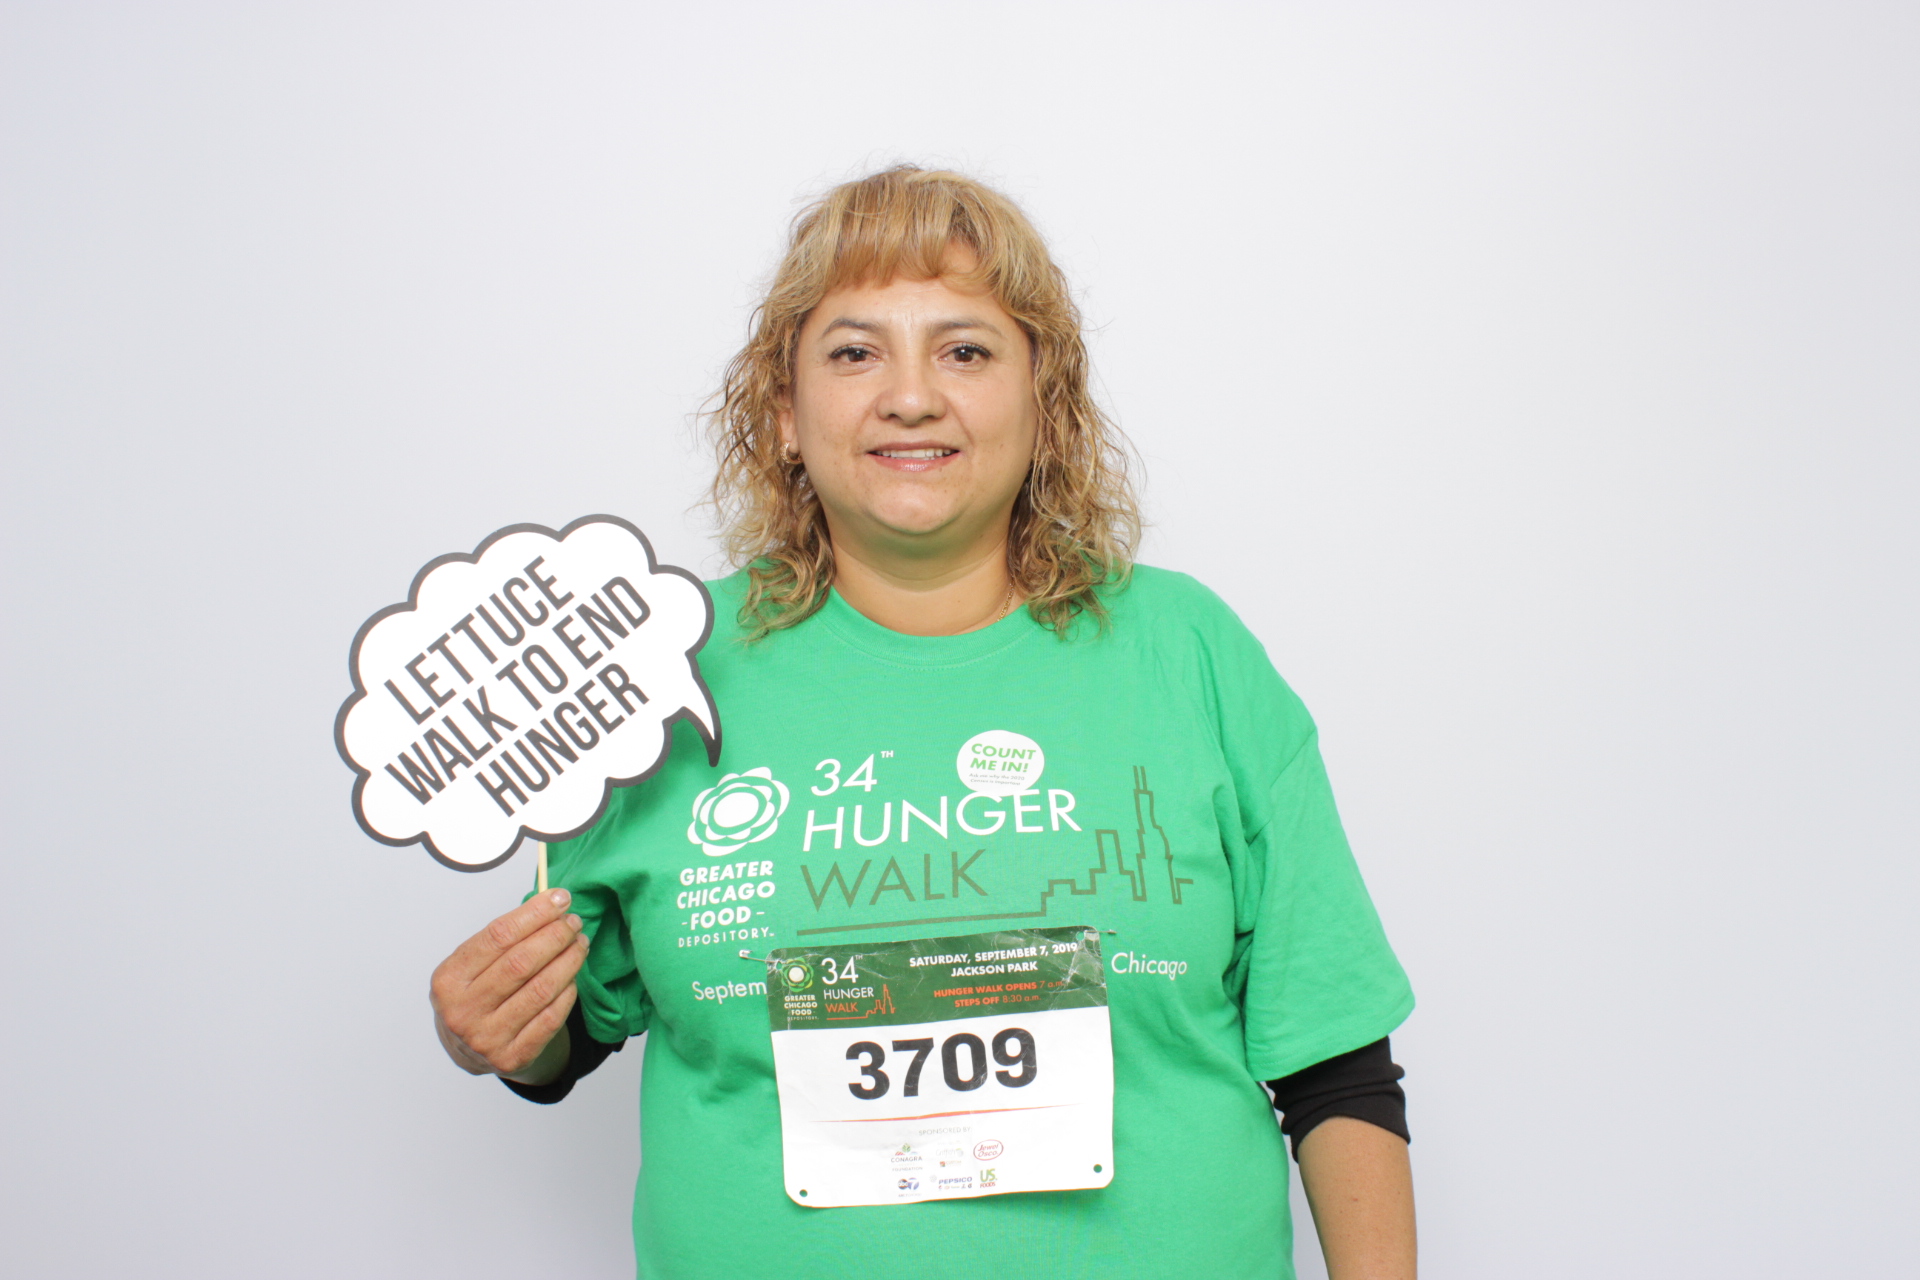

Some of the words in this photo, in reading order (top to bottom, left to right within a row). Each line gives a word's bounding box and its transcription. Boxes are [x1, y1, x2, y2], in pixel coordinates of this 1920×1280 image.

[384, 555, 575, 725] LETTUCE
[384, 685, 518, 805] WALK
[495, 644, 569, 711] TO
[551, 576, 651, 670] END
[474, 663, 650, 817] HUNGER
[971, 743, 1036, 760] COUNT
[970, 757, 997, 771] ME
[1001, 761, 1029, 773] IN!
[803, 788, 1082, 852] HUNGER
[680, 860, 774, 886] GREATER
[800, 848, 988, 912] WALK
[677, 881, 776, 909] CHICAGO
[909, 953, 972, 968] SATURDAY,
[975, 946, 1038, 962] SEPTEMBER
[1039, 945, 1049, 957] 7,
[1052, 942, 1078, 954] 2019
[951, 964, 1005, 977] JACKSON
[1007, 961, 1039, 973] PARK
[1110, 951, 1189, 981] Chicago
[784, 994, 816, 1002] GREATER
[823, 987, 874, 1000] HUNGER
[934, 987, 974, 998] HUNGER
[976, 984, 1003, 994] WALK
[1005, 982, 1037, 992] OPENS
[1039, 980, 1046, 989] 7
[825, 1002, 859, 1013] WALK
[954, 998, 981, 1008] STEPS
[982, 996, 1000, 1006] OFF
[1002, 994, 1022, 1004] 8:30
[1024, 994, 1042, 1003] a.m.
[846, 1027, 1038, 1101] 3709
[918, 1127, 962, 1136] SPONSORED
[978, 1143, 999, 1152] Jewel
[938, 1176, 972, 1185] PEPSICO
